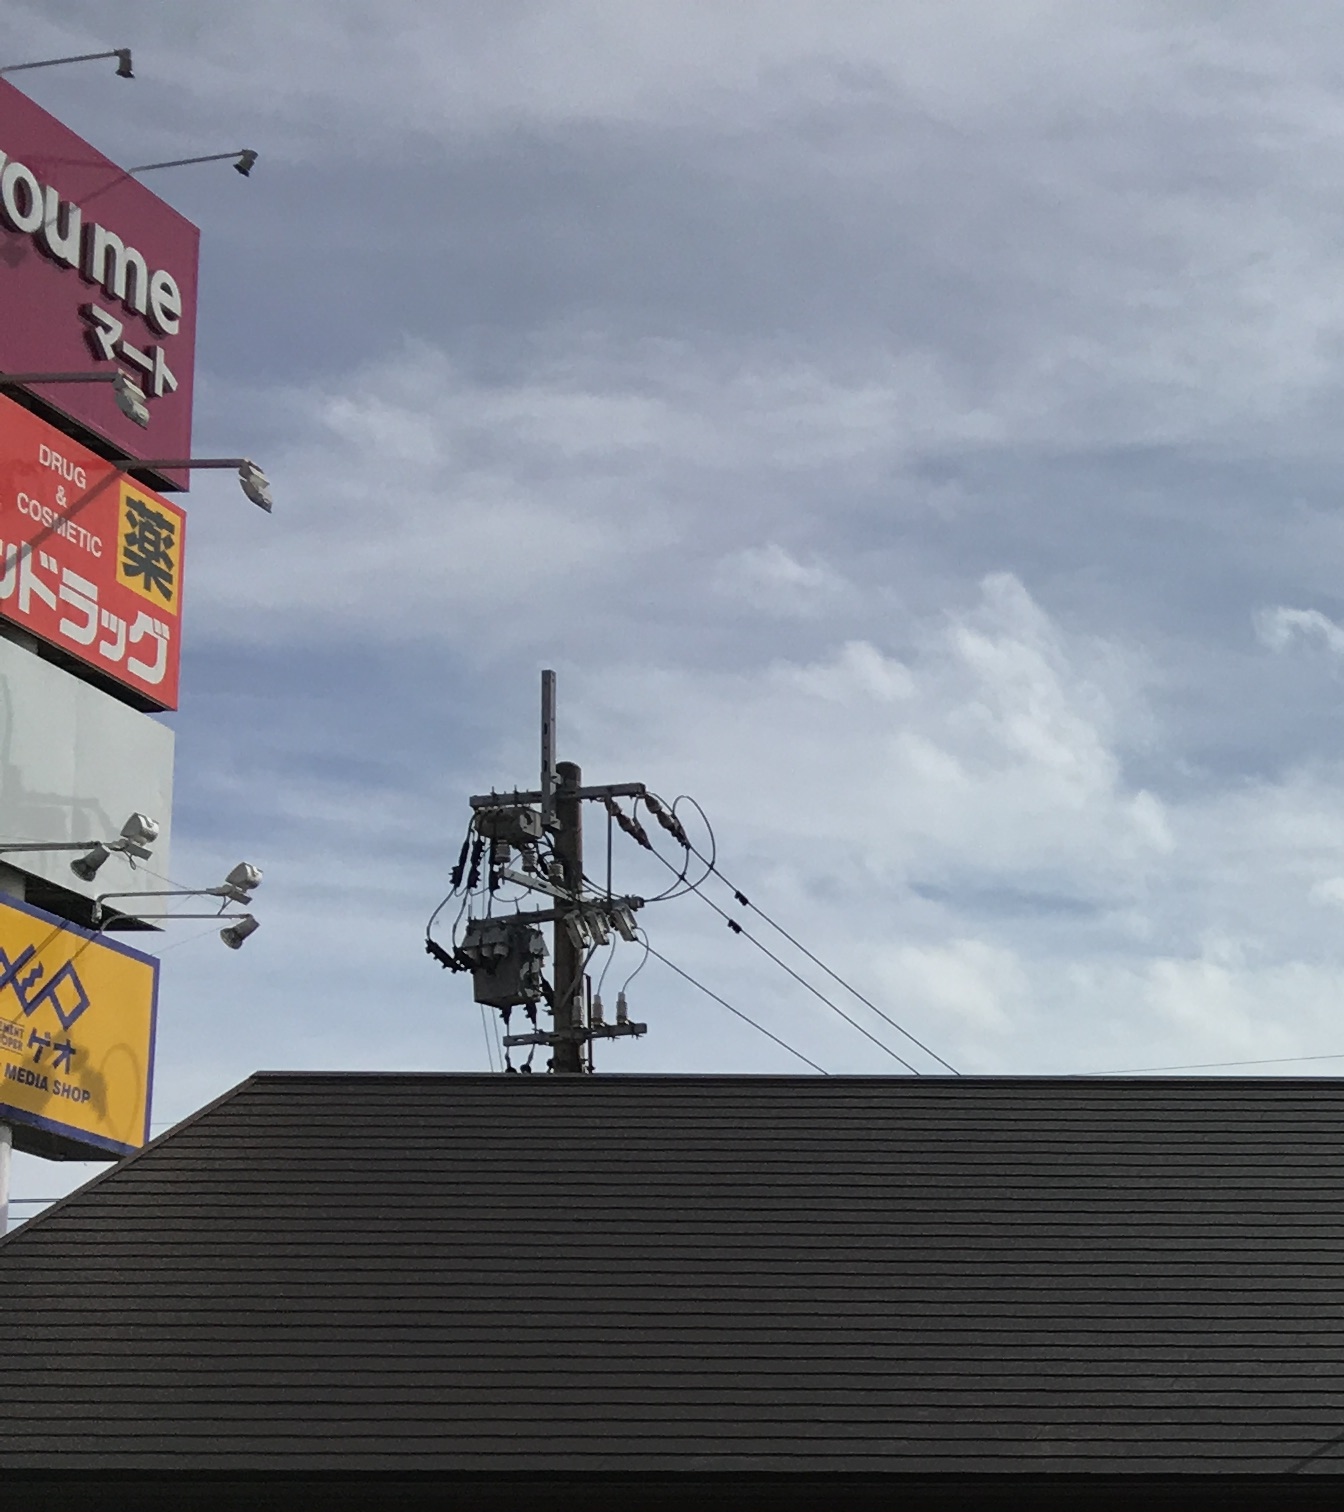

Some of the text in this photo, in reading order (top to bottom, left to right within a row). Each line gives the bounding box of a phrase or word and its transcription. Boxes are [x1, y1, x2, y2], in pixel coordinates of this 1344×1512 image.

[0, 147, 182, 335] oume
[90, 302, 178, 398] マート
[39, 443, 87, 490] DRUG
[55, 485, 68, 508] &
[17, 492, 103, 558] COSMETIC
[121, 494, 175, 602] 薬
[27, 1027, 76, 1074] ゲオ
[4, 1062, 91, 1104] MEDIA SHOP
